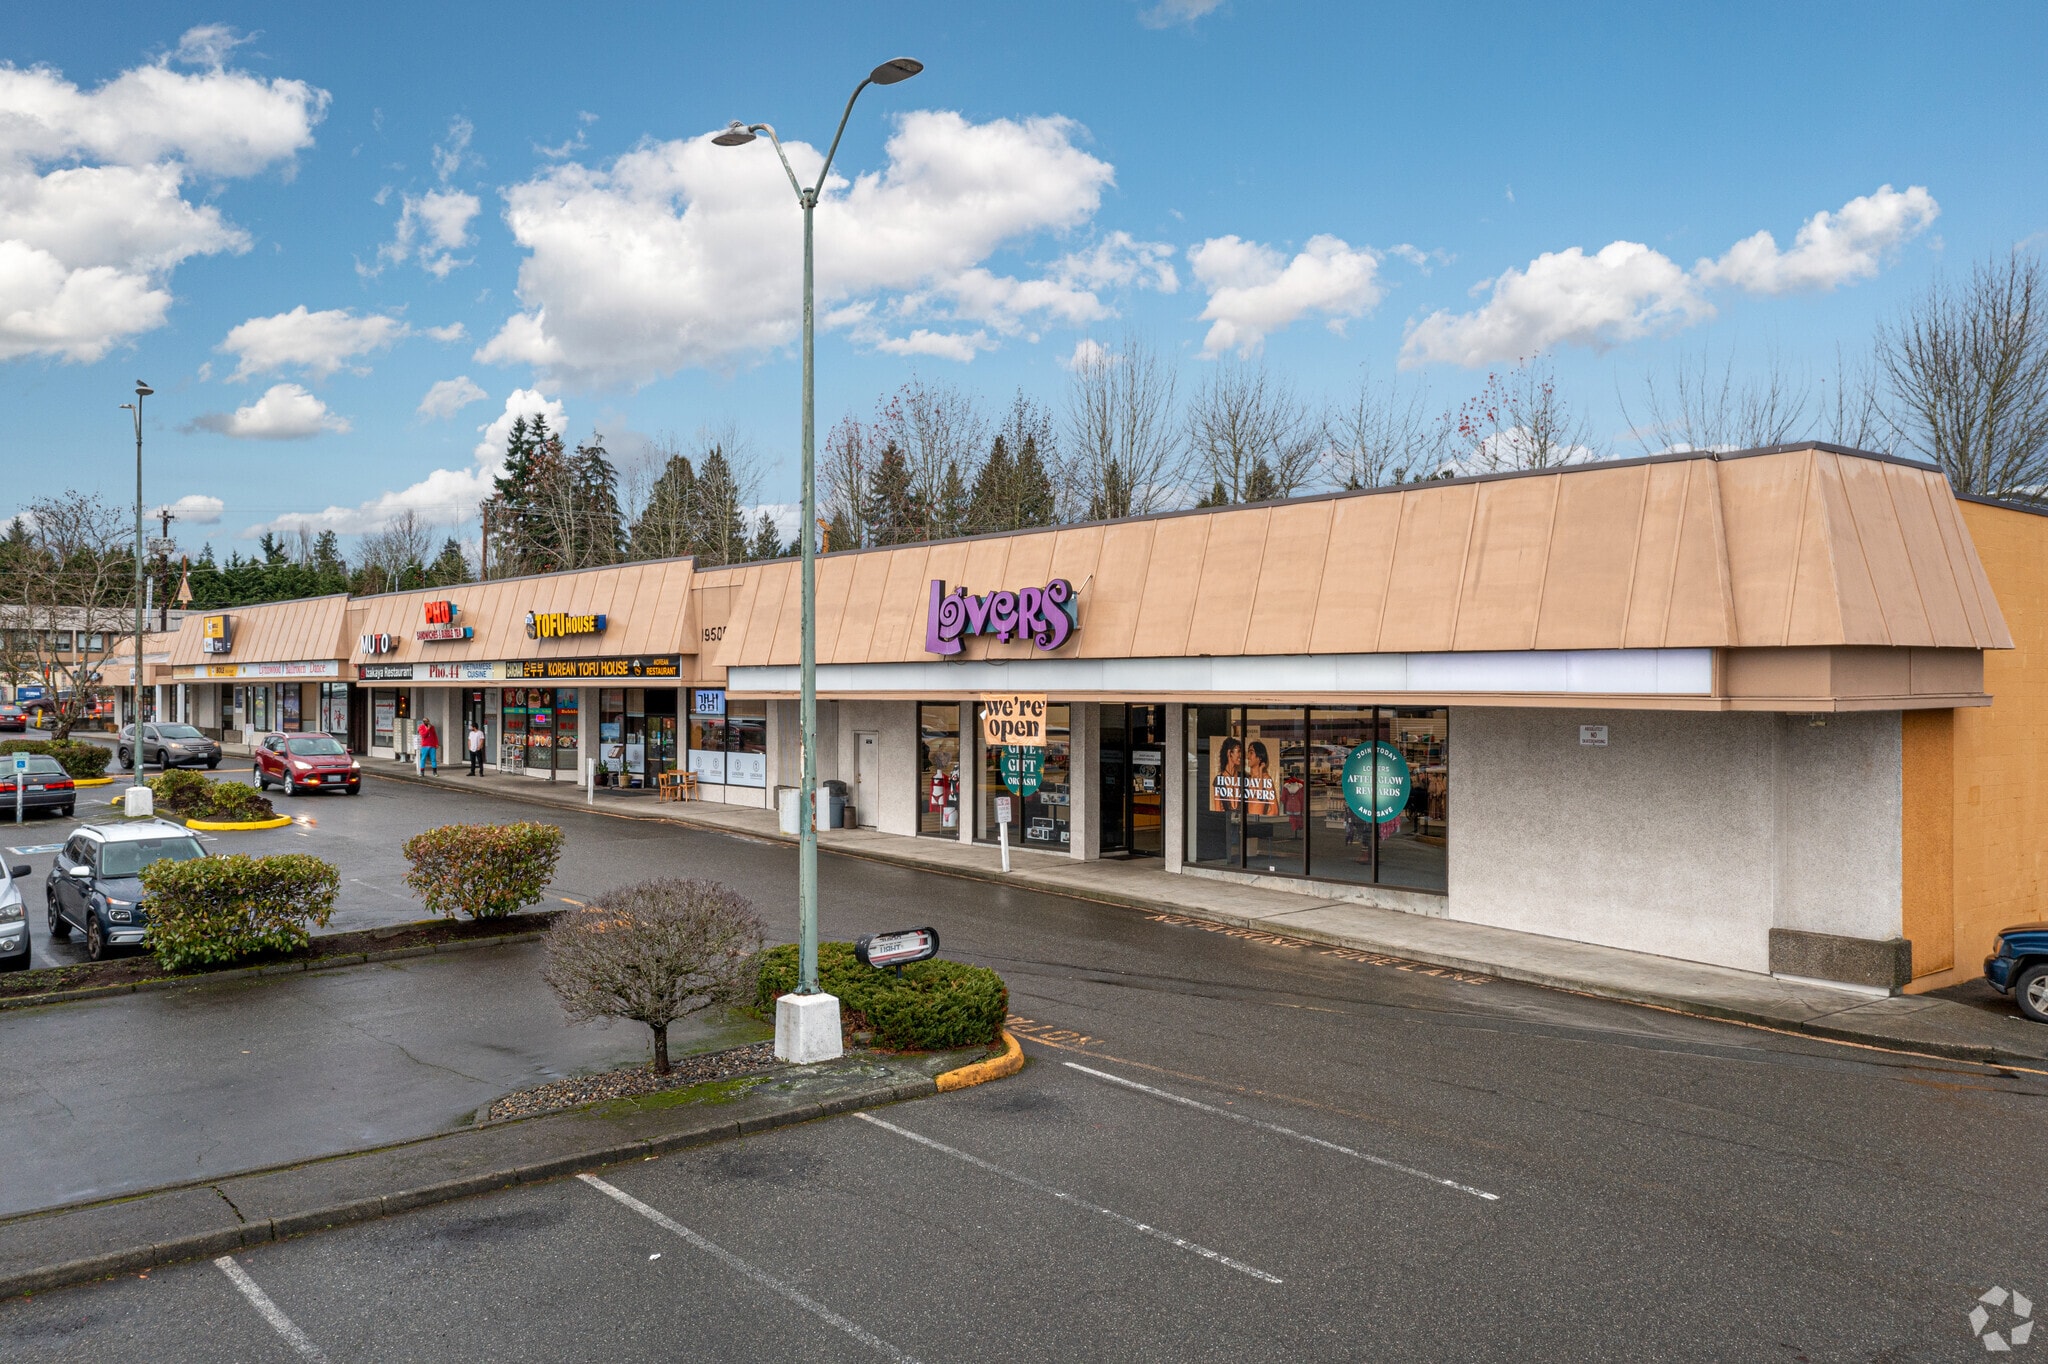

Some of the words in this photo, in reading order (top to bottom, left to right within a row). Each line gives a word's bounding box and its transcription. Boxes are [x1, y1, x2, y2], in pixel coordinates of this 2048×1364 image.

[424, 600, 450, 624] PHO
[535, 613, 565, 638] TOFU
[566, 616, 595, 634] HOUSE
[361, 633, 389, 654] MUTO
[259, 663, 281, 676] Lynnwood
[285, 662, 306, 675] Ballroom
[310, 662, 326, 673] Dance
[384, 666, 412, 678] Restaurant
[462, 662, 492, 671] VIETNAMESE
[524, 662, 544, 678] 순두부
[548, 662, 576, 677] KOREAN
[578, 662, 599, 676] TOFU
[601, 660, 628, 676] HOUSE
[646, 666, 676, 675] RESTAURANT
[698, 692, 719, 712] 강남
[985, 696, 1044, 717] we're
[989, 719, 1039, 742] open
[1356, 747, 1372, 759] JOIN
[1377, 747, 1397, 761] TODAY
[1008, 759, 1036, 773] GIFT
[1362, 765, 1390, 773] LOERS
[1216, 775, 1261, 788] HOLIDAY
[1263, 778, 1272, 788] IS
[1214, 786, 1233, 797] FOR
[1235, 788, 1275, 800] LOVERS
[1358, 806, 1372, 817] AND
[1377, 806, 1393, 817] SAVE
